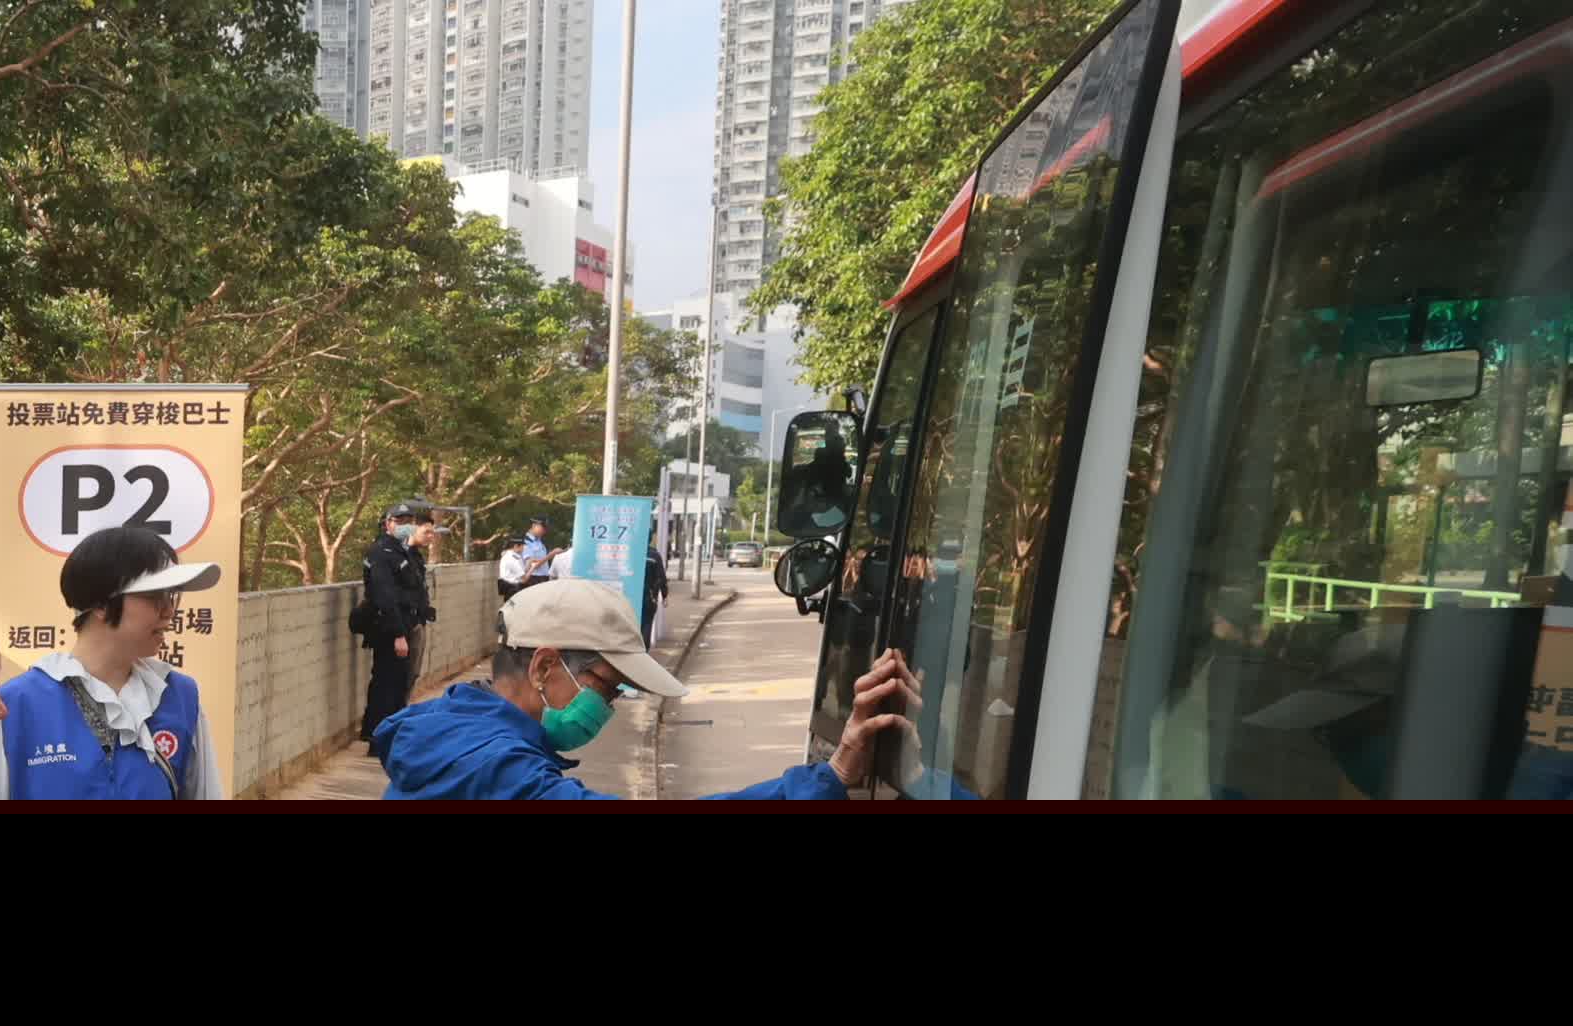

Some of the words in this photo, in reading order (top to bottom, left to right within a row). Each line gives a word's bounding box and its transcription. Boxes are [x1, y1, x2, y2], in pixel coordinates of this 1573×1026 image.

[7, 401, 230, 426] 投票站免費穿梭巴士
[61, 464, 172, 535] P2
